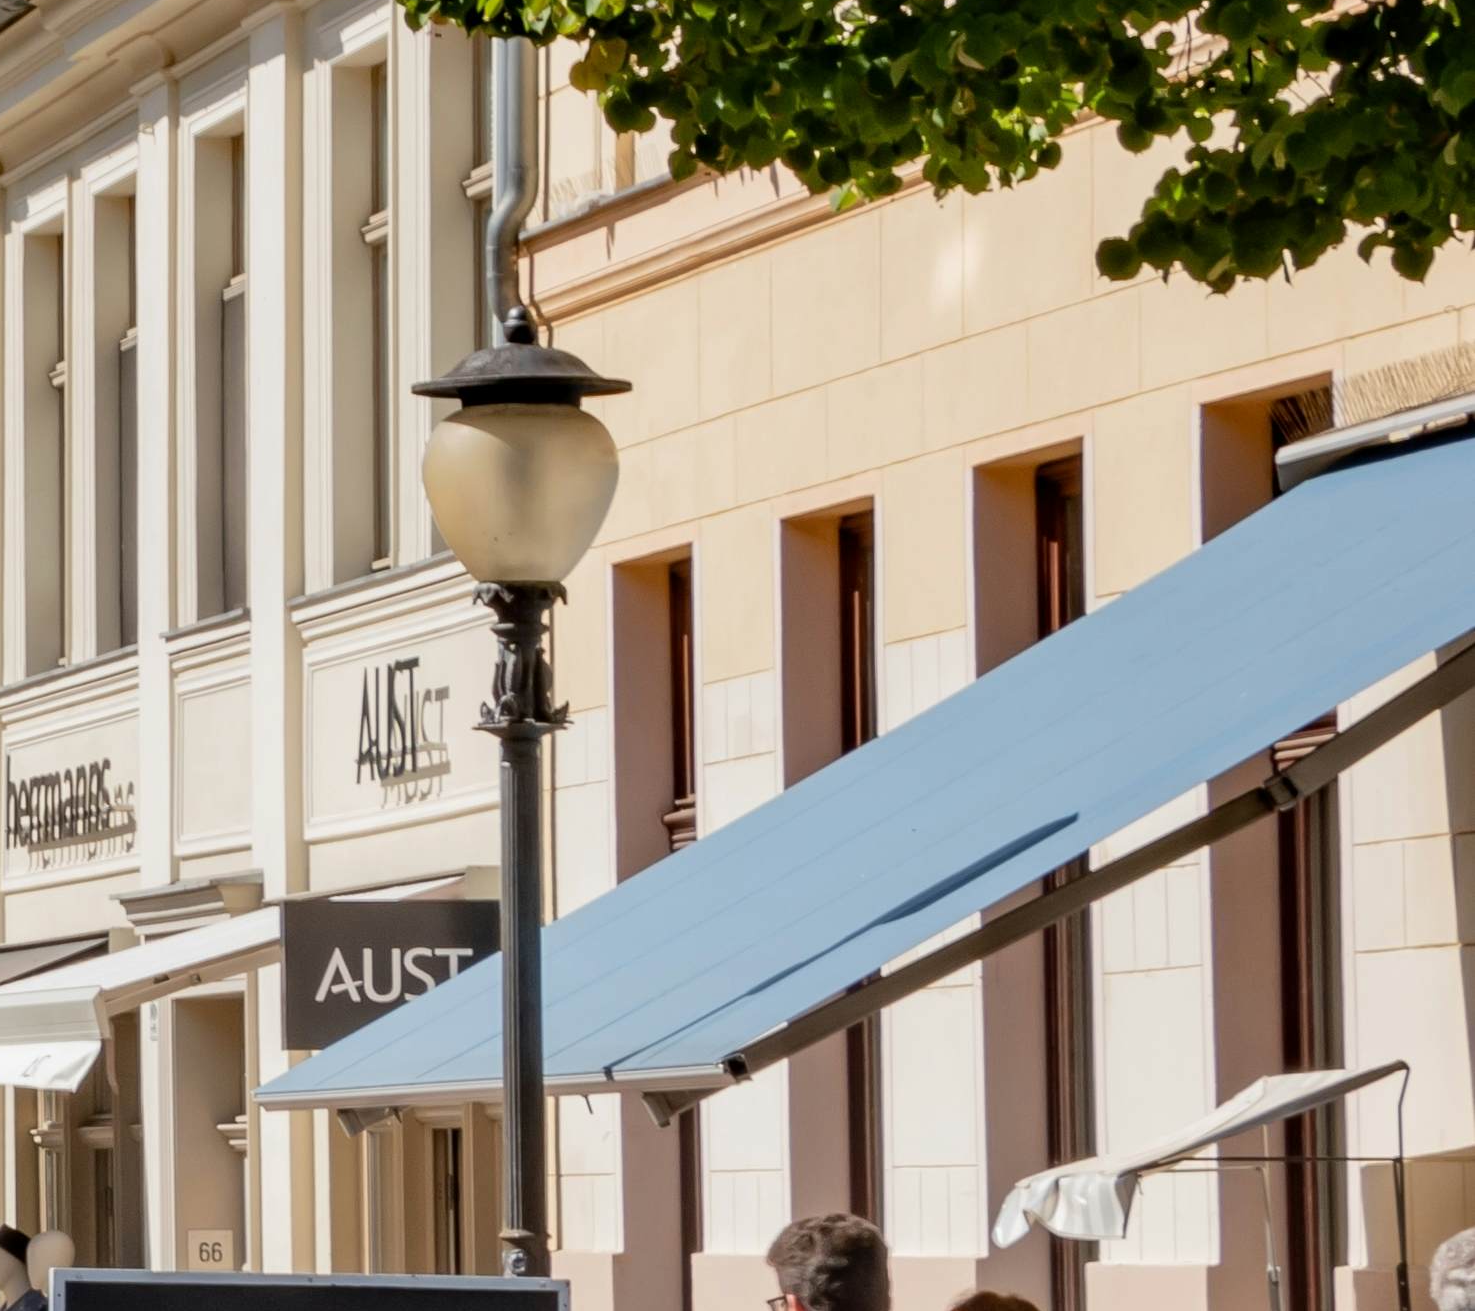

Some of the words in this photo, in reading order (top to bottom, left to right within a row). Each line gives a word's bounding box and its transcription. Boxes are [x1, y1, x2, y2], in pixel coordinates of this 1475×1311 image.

[355, 657, 420, 785] AUST
[314, 946, 474, 1003] AUST
[199, 1241, 223, 1263] 66
